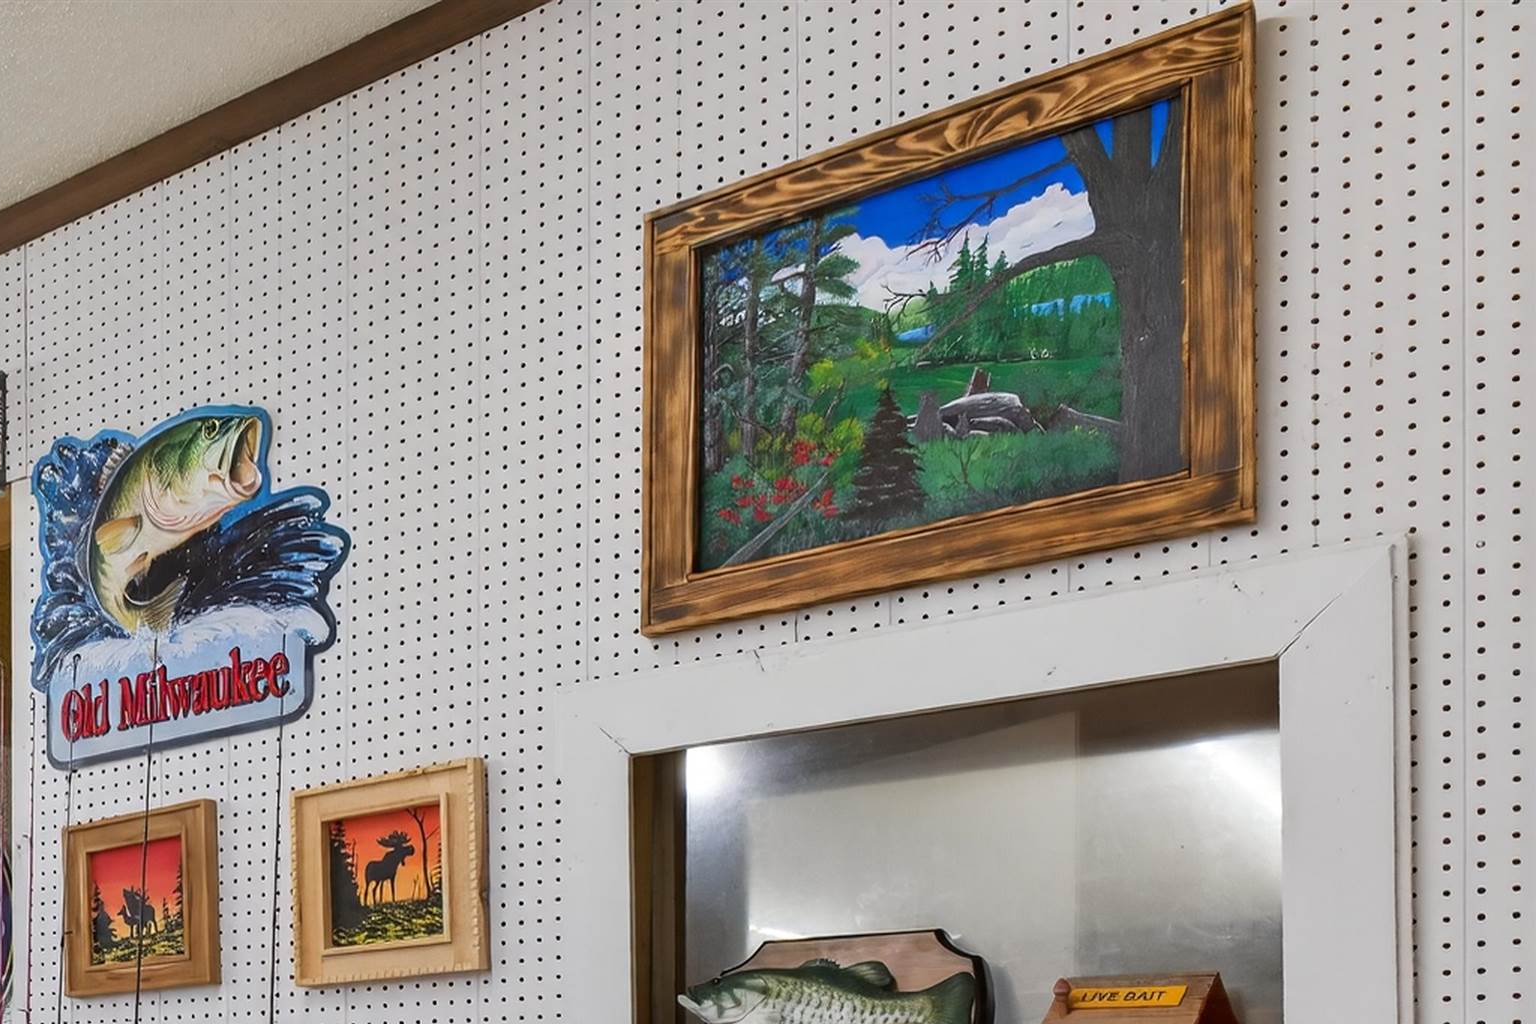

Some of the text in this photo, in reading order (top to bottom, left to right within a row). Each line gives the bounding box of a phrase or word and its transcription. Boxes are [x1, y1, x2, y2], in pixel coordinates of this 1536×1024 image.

[60, 646, 291, 741] Old Milwaukee
[1080, 990, 1168, 1002] LIVE BAIT
